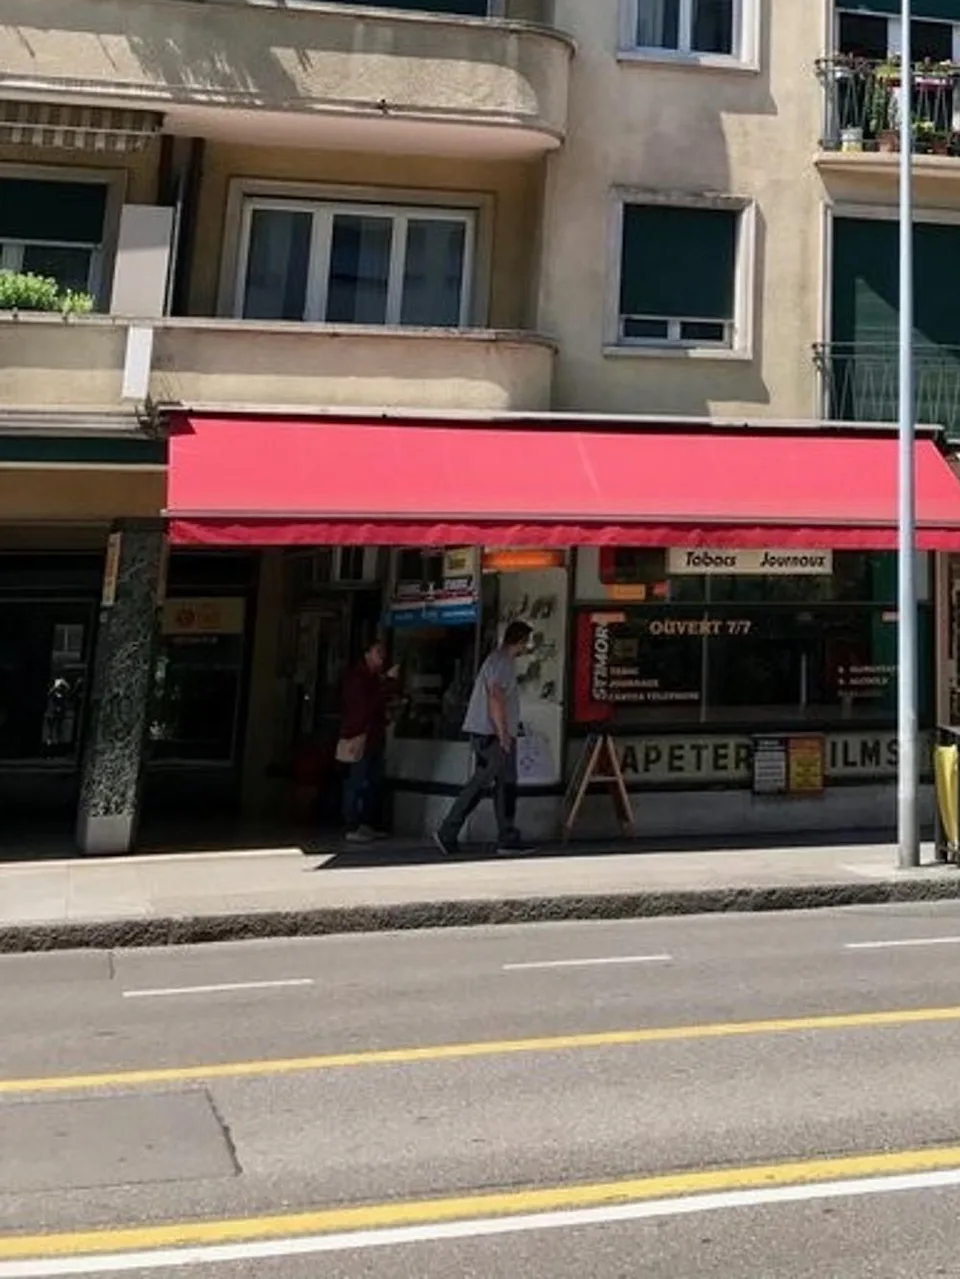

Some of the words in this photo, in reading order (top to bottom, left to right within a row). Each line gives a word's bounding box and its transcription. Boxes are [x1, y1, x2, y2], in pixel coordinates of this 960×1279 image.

[686, 551, 737, 567] Tabacs
[760, 552, 826, 568] Journaux
[649, 619, 723, 635] OUVERT
[621, 744, 751, 774] APETER
[831, 738, 898, 769] ILMS
